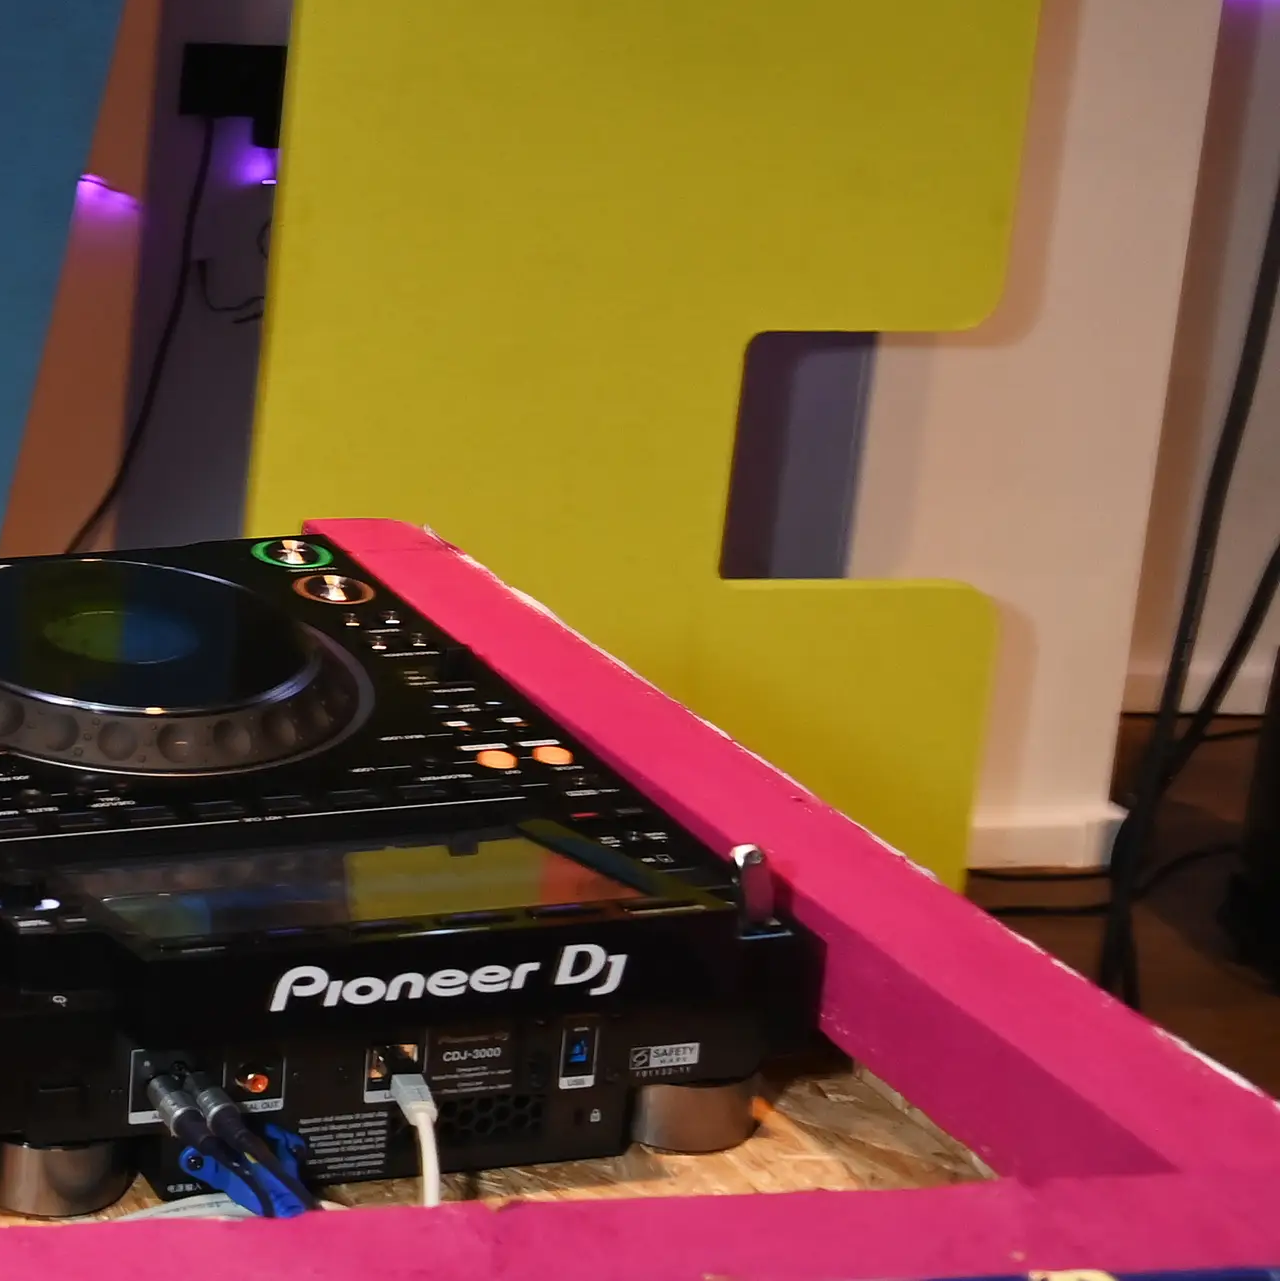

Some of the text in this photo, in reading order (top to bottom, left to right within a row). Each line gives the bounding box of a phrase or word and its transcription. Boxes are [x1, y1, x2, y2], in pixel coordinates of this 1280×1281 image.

[268, 959, 541, 1013] Pioneer
[442, 1046, 502, 1063] CDJ-3000
[652, 1046, 696, 1059] SAFETY
[260, 1100, 281, 1110] OUT
